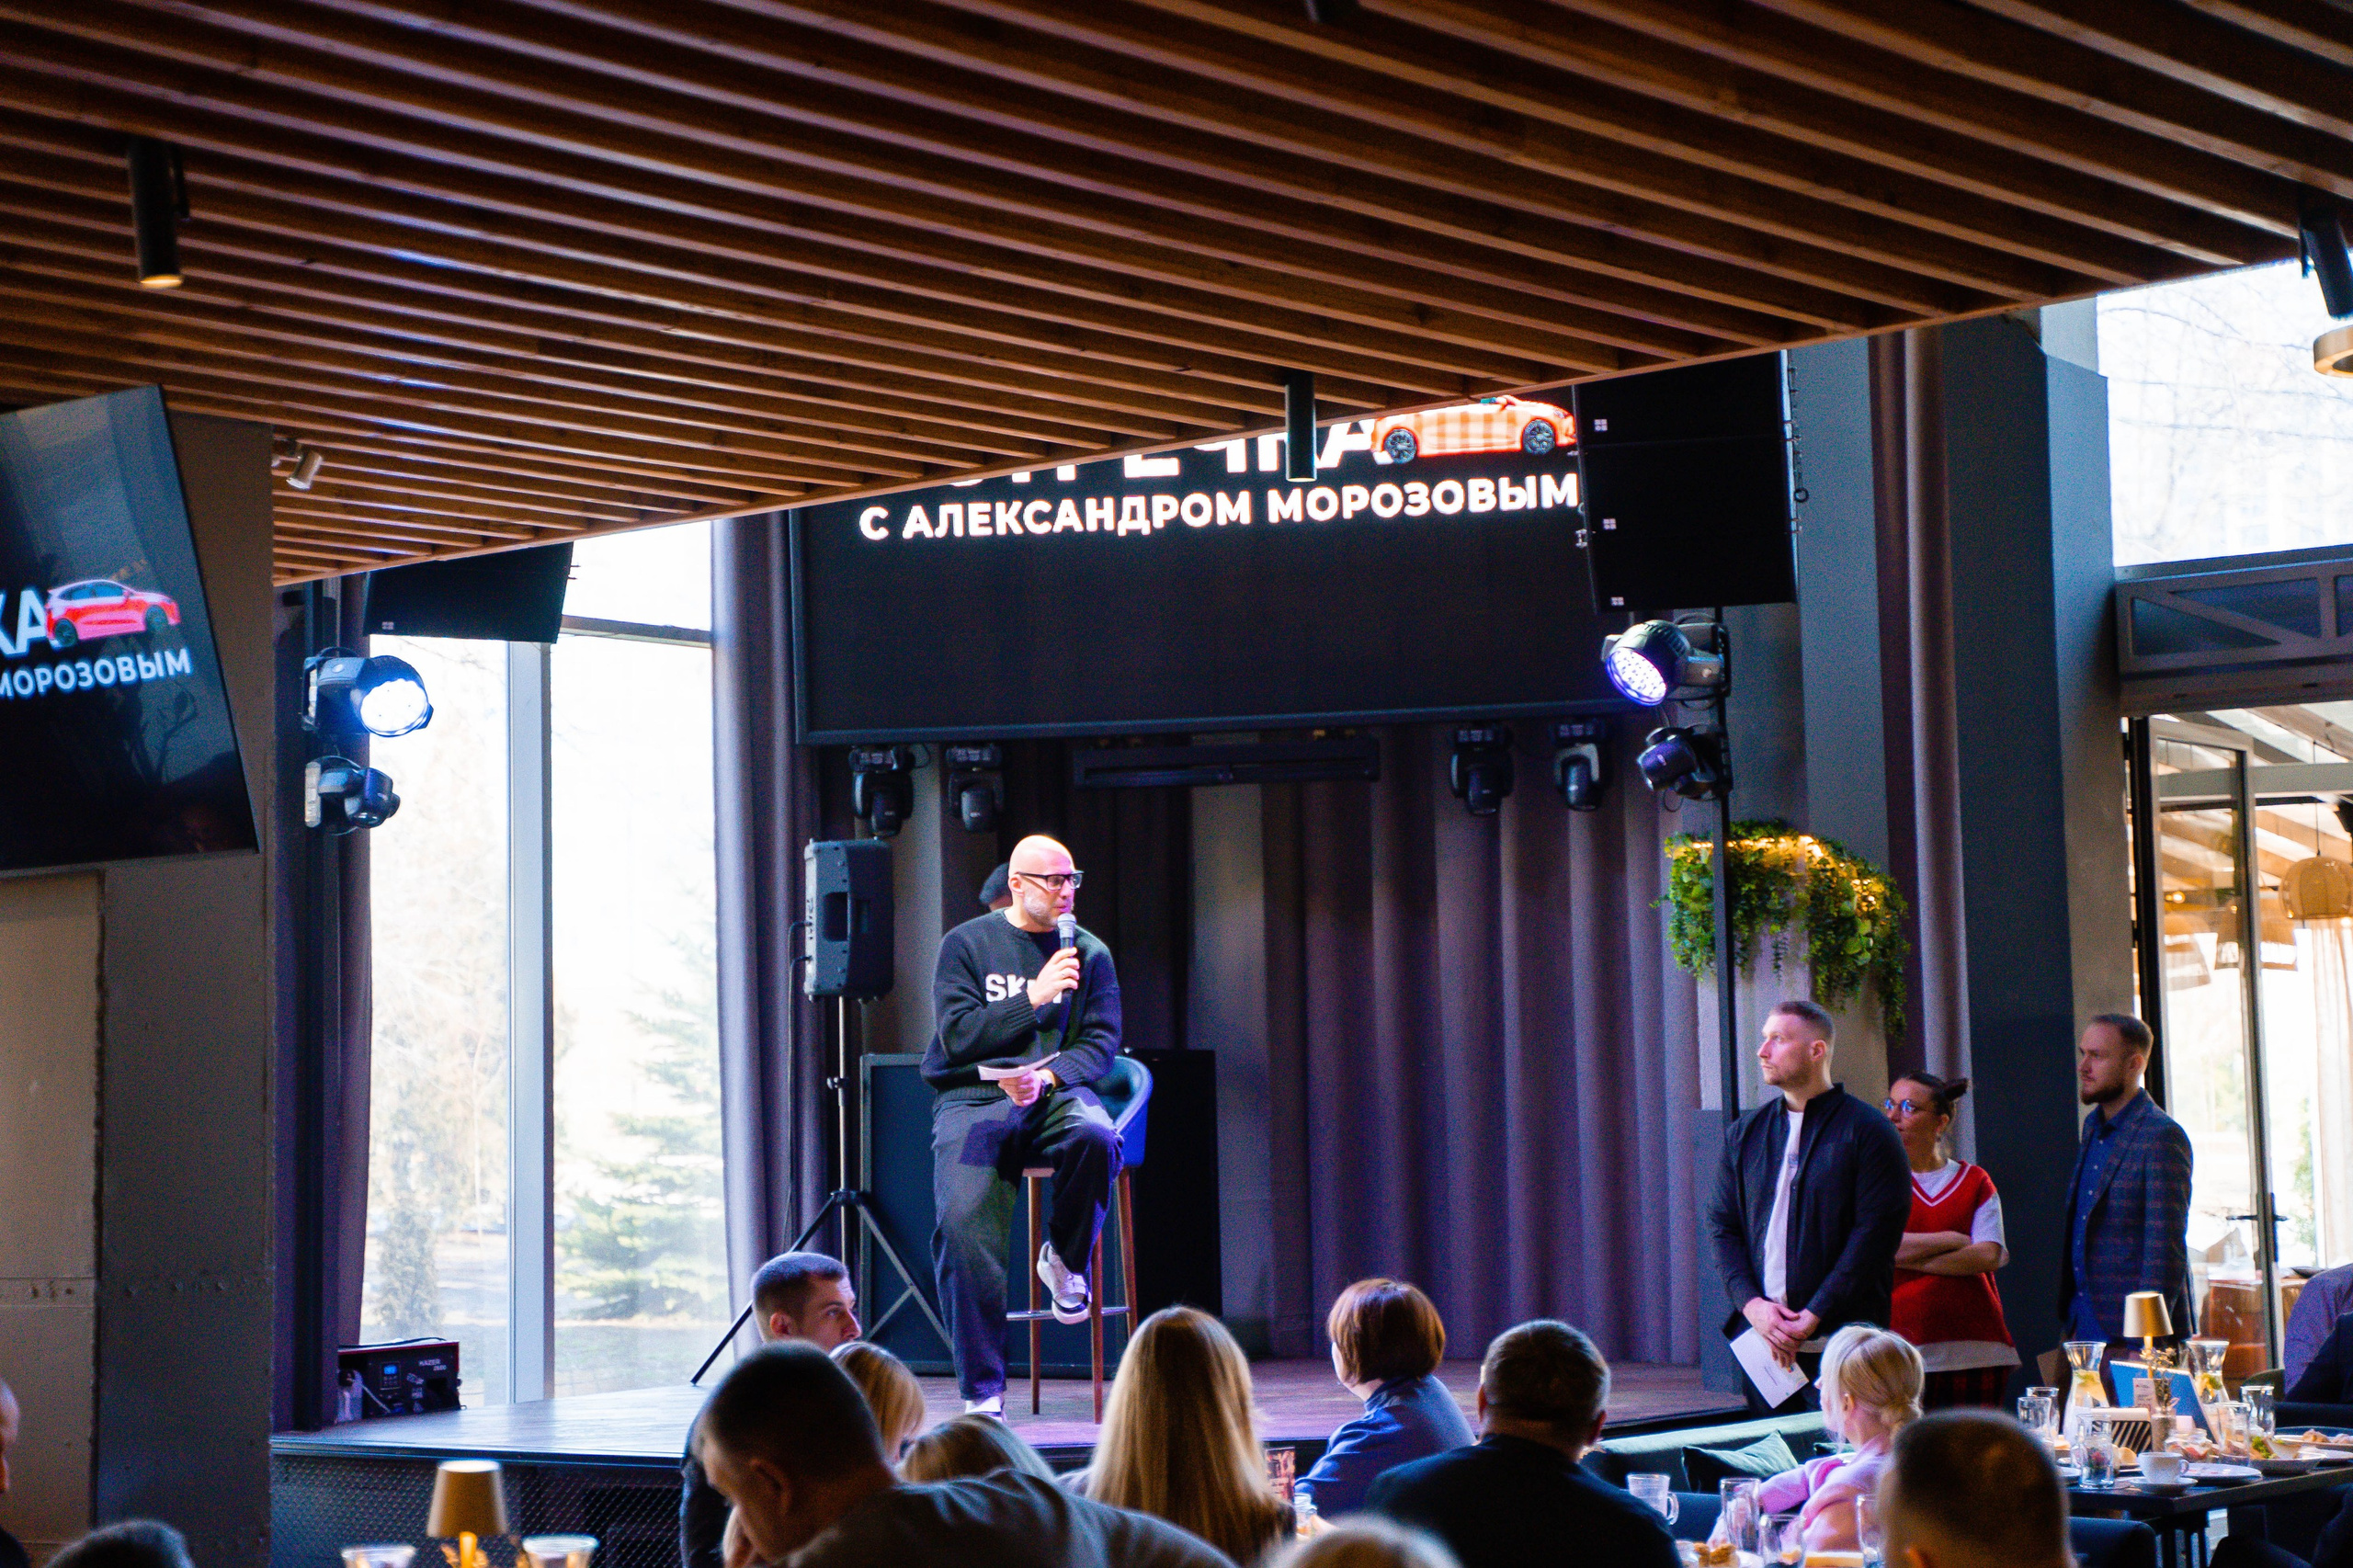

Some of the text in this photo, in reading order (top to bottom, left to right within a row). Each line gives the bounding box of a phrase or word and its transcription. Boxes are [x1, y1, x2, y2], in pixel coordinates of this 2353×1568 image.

[859, 472, 1578, 540] С АЛЕКСАНДРОМ МОРОЗОВЫМ
